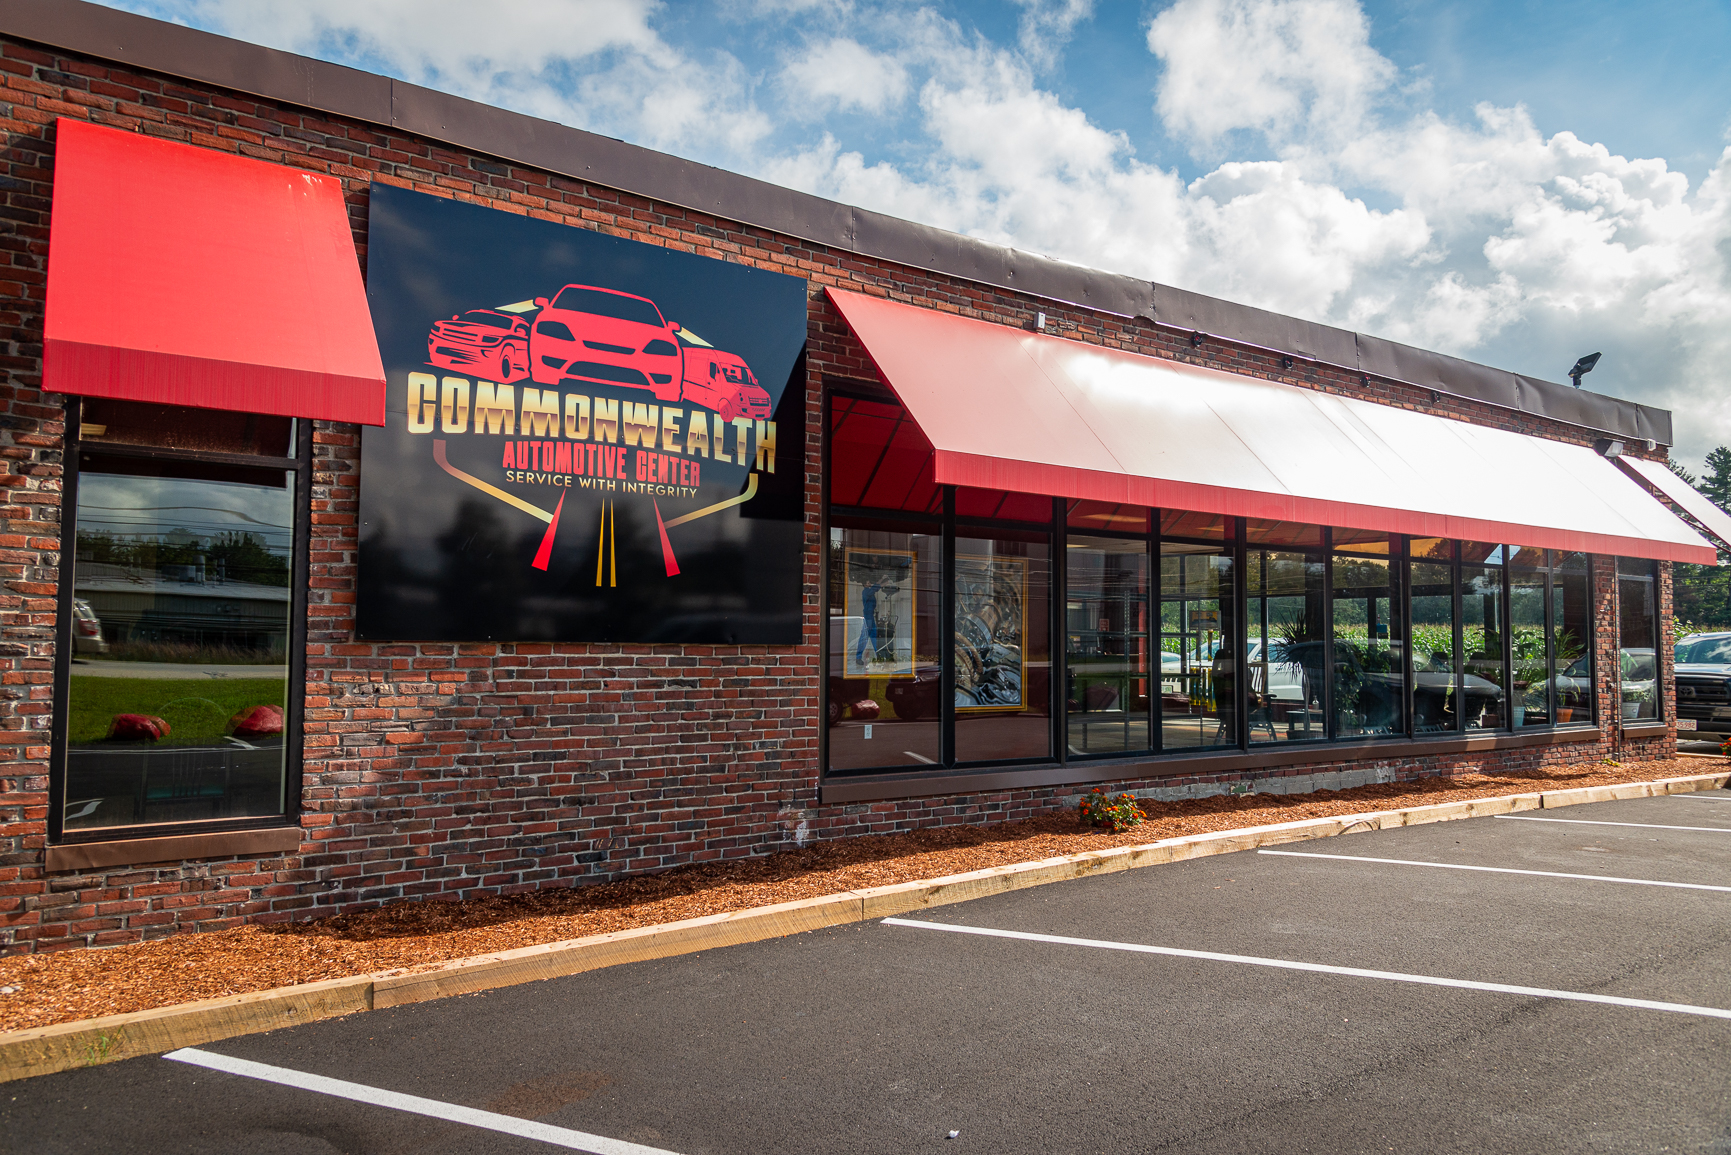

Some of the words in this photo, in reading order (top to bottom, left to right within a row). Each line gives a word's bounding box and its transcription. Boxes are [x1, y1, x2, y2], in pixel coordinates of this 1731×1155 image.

[407, 371, 777, 474] COMMONWEALTH
[502, 441, 627, 480] AUTOMOTIVE
[636, 450, 700, 487] CENTER
[506, 470, 573, 487] SERVICE
[579, 477, 616, 492] WITH
[622, 481, 697, 498] INTEGRITY
